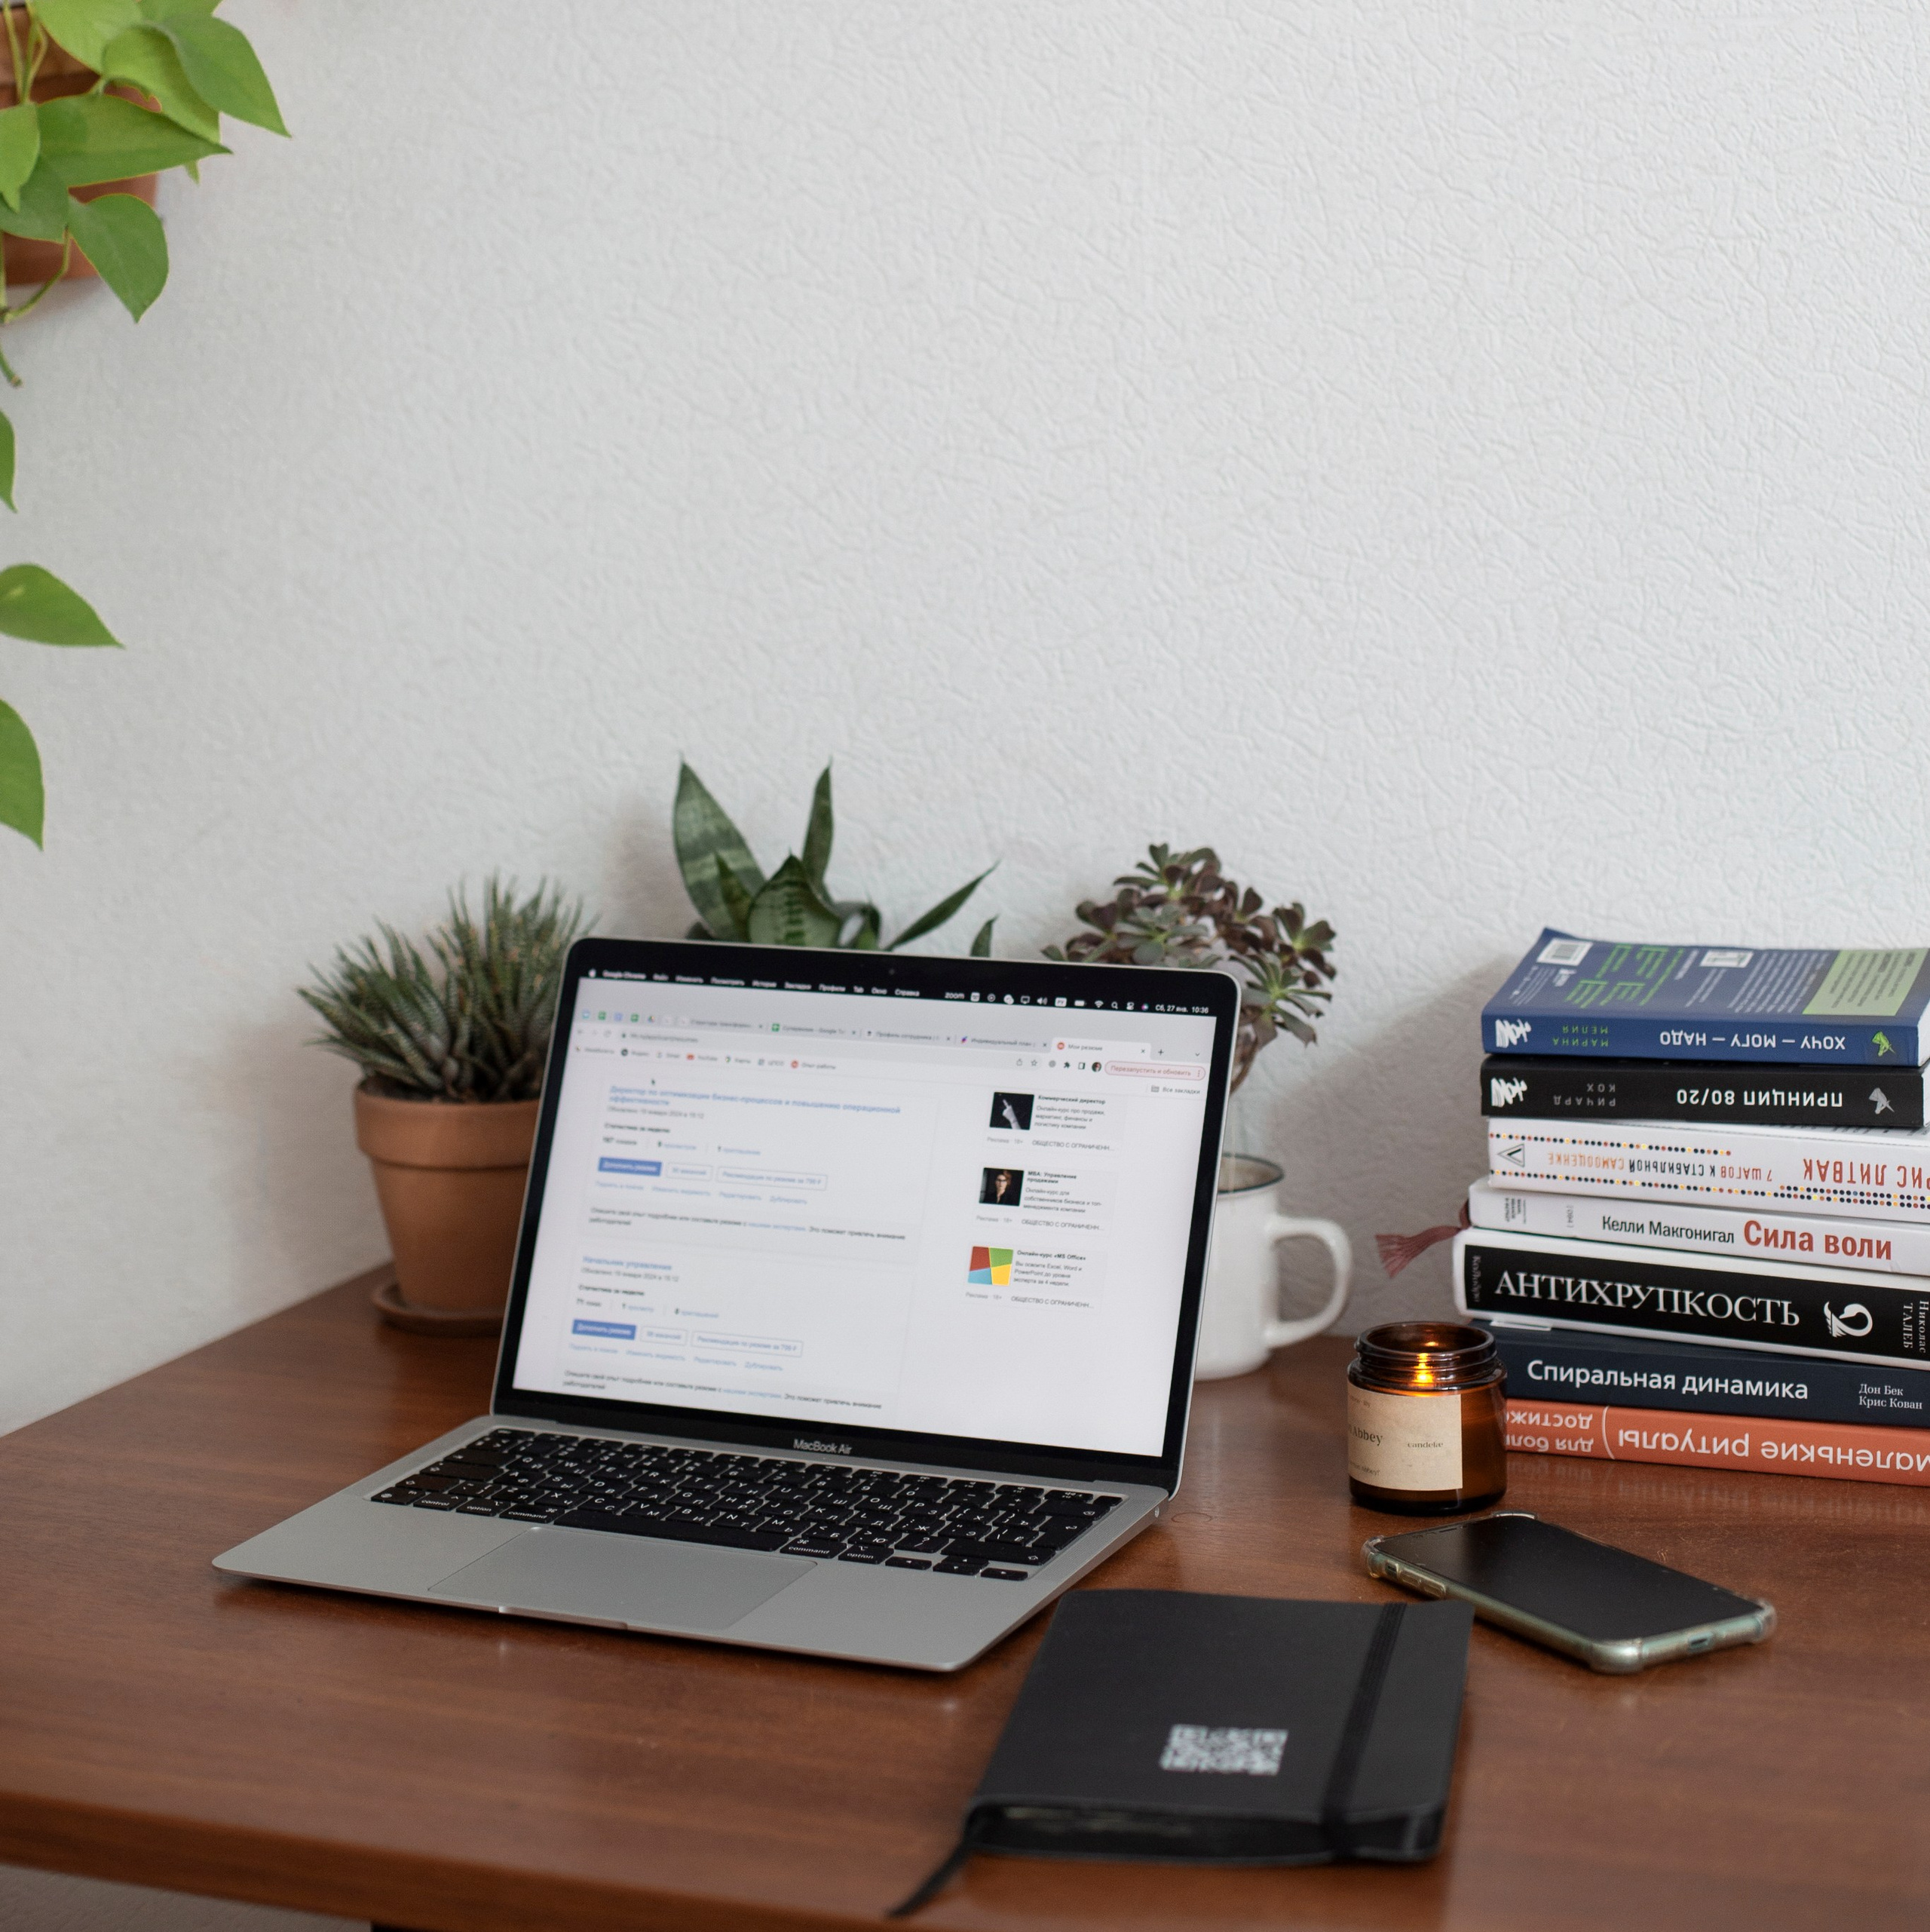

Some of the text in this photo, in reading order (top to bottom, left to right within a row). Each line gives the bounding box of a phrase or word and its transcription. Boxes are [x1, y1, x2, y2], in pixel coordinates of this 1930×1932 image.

[819, 984, 845, 992] Профили
[895, 989, 919, 997] Справка
[1562, 1026, 1609, 1035] МЕЛИЯ
[1553, 1038, 1609, 1047] МАРИНА
[1660, 1032, 1846, 1050] ХОЧУ МОГУ НАДО
[1111, 1066, 1156, 1074] Перезапустить
[1586, 1084, 1616, 1093] КОХ
[1553, 1096, 1616, 1107] РИЧАРД
[1677, 1089, 1843, 1108] ПРИНЦИП 80/20
[1036, 1106, 1069, 1114] Онлайн-курс
[1547, 1152, 1772, 1181] 7 ШАГОВ К СТАБИЛЬНОЙ САМООЦЕНКЕ
[1803, 1158, 1891, 1185] ЛИТВАК
[1025, 1187, 1058, 1195] Онлайн-курс
[1602, 1216, 1735, 1244] Келли Макгонигал
[1744, 1220, 1892, 1260] Сила воли
[1011, 1296, 1043, 1304] ОБЩЕСТВО
[1495, 1270, 1799, 1326] АНТИХРУПКОСТЬ
[1903, 1303, 1913, 1349] ТАЛЕБ
[1918, 1301, 1927, 1354] Николас
[1527, 1360, 1808, 1400] Спиральная динамика
[1858, 1384, 1904, 1397] Дон Бек
[1858, 1397, 1922, 1409] Крис Кован
[1353, 1426, 1383, 1446] Abbey
[1619, 1429, 1748, 1458] ритуалы
[794, 1439, 852, 1455] MacBook Air
[1555, 1437, 1593, 1453] для
[789, 1546, 829, 1554] command
